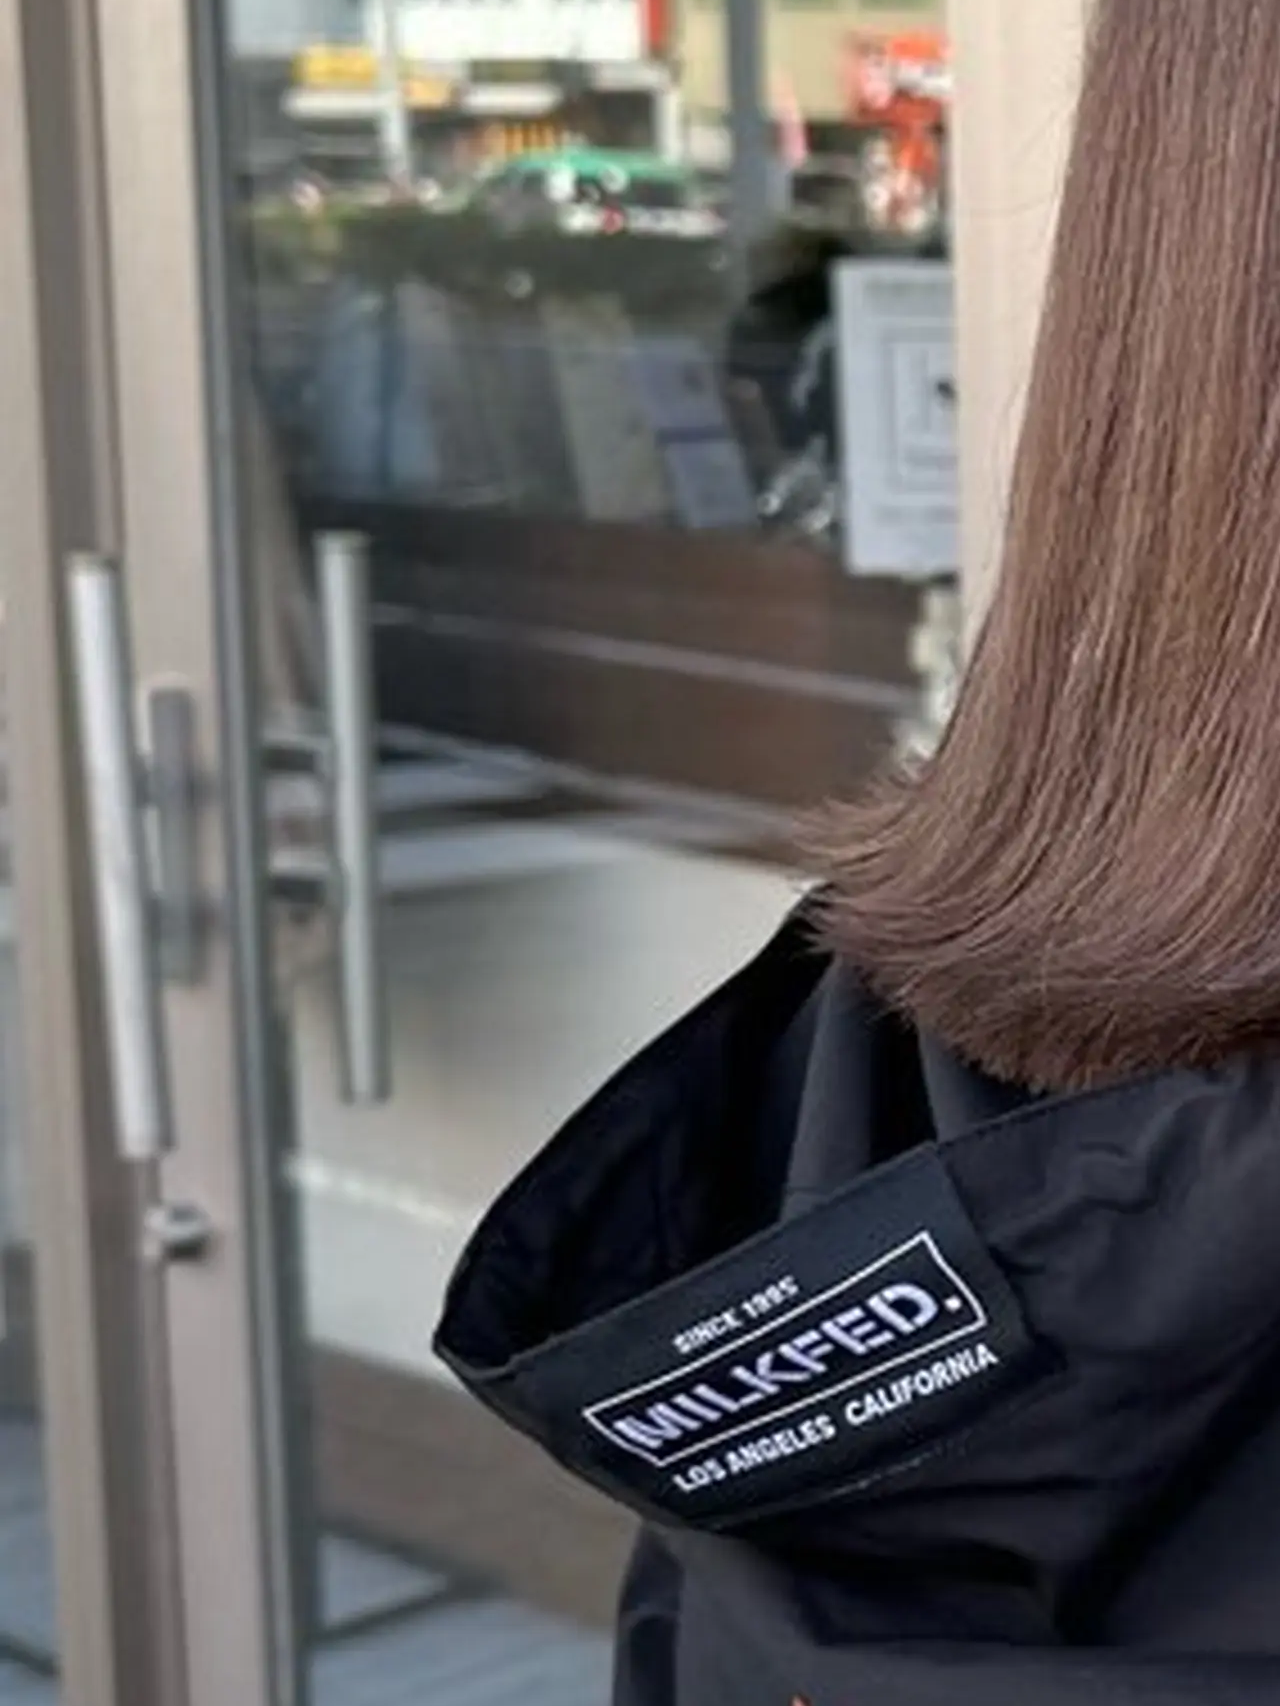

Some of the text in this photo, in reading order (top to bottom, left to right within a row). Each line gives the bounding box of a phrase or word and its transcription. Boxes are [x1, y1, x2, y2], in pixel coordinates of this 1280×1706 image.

[612, 1283, 962, 1450] MILKFED.
[672, 1307, 743, 1355] SINCE
[672, 1343, 999, 1494] LOS ANGELES CALIFORNIA
